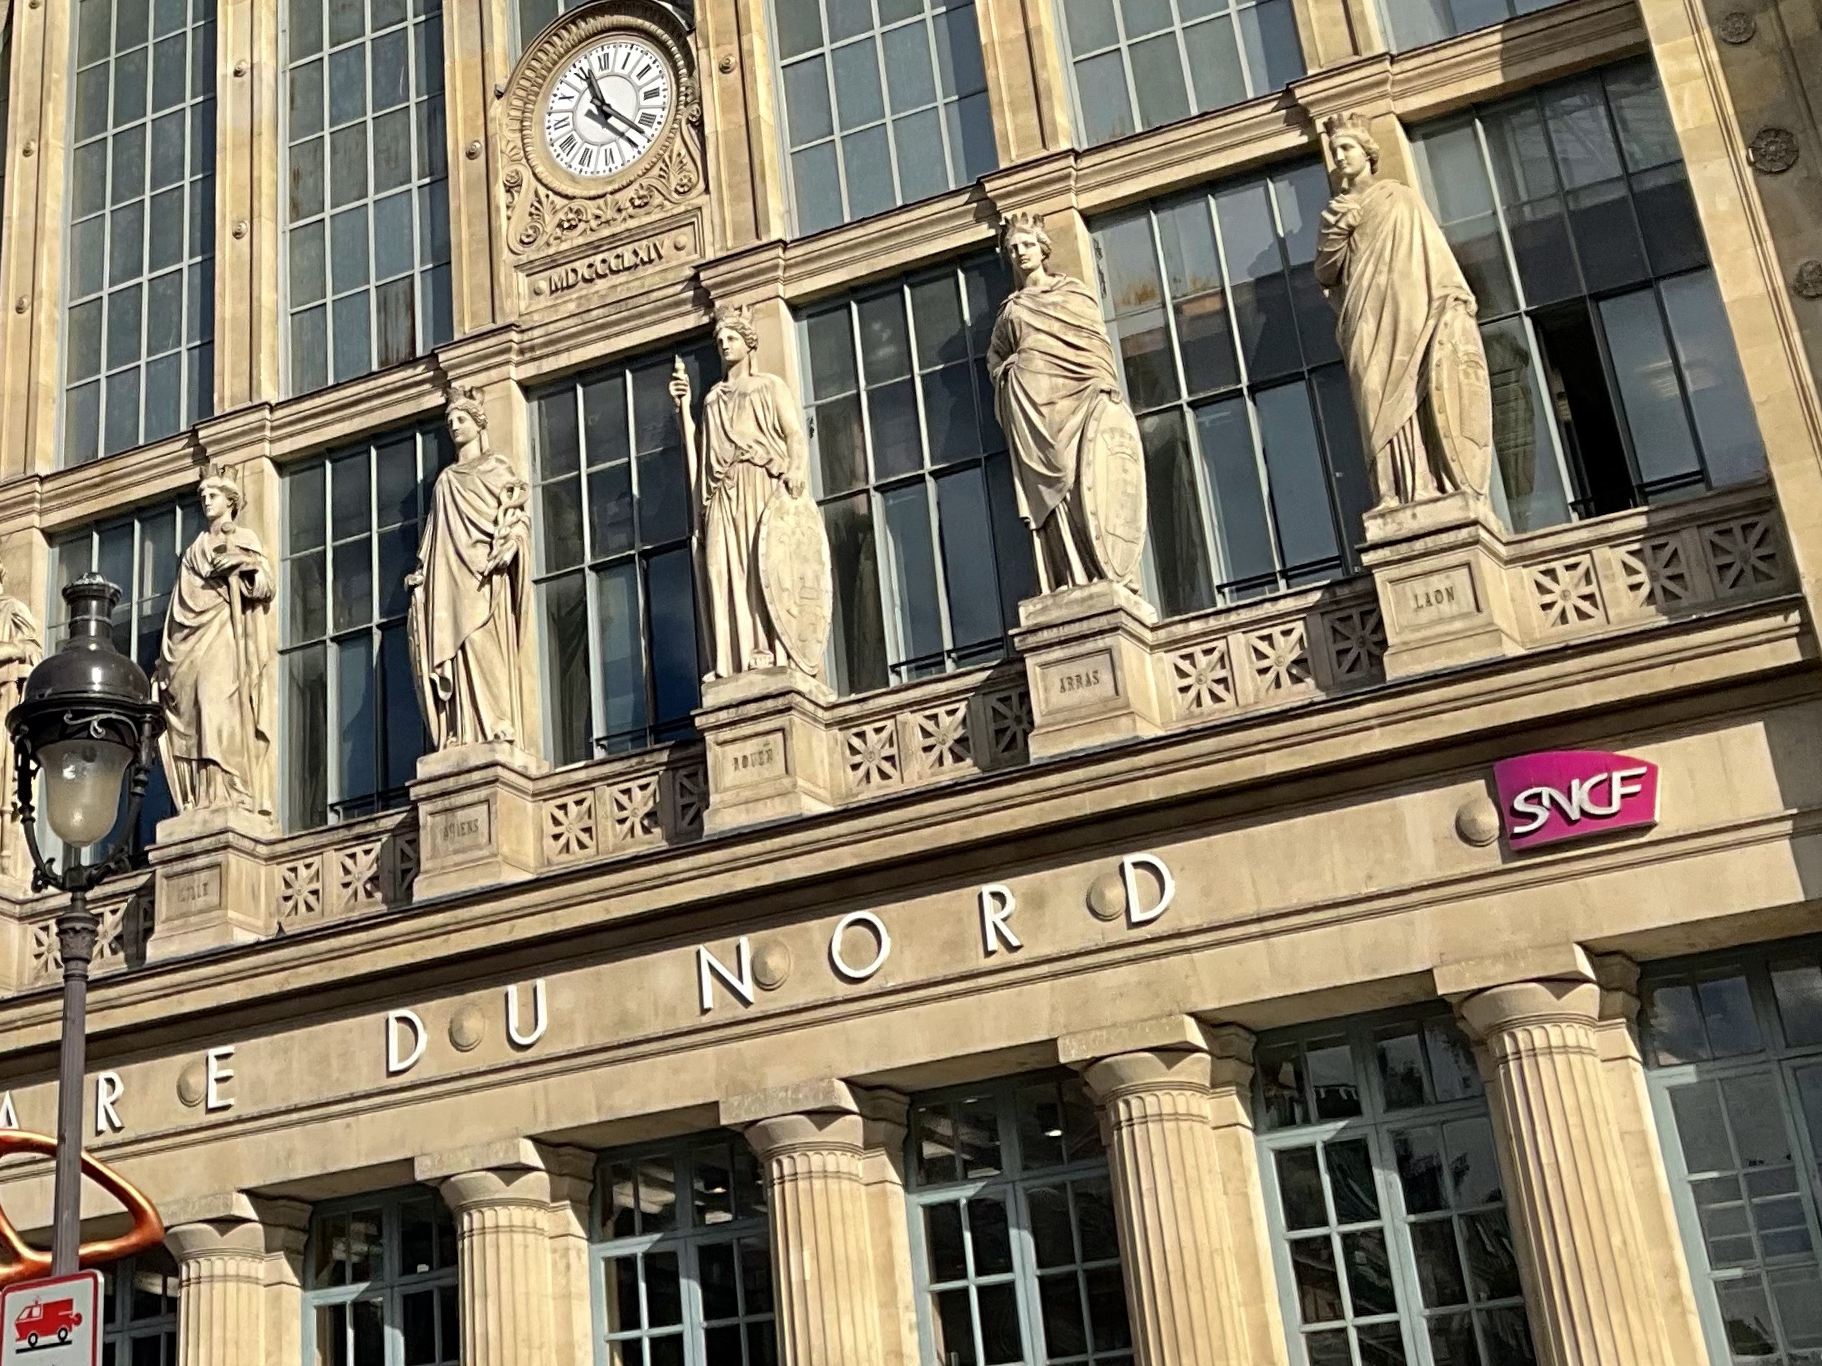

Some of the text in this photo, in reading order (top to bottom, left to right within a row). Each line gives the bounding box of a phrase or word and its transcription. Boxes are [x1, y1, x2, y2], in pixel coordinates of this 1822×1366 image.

[1413, 586, 1456, 609] LAON
[1059, 669, 1100, 694] ARRAS
[1511, 766, 1648, 834] SNCF
[386, 978, 548, 1073] DU
[696, 852, 1176, 1011] NORD
